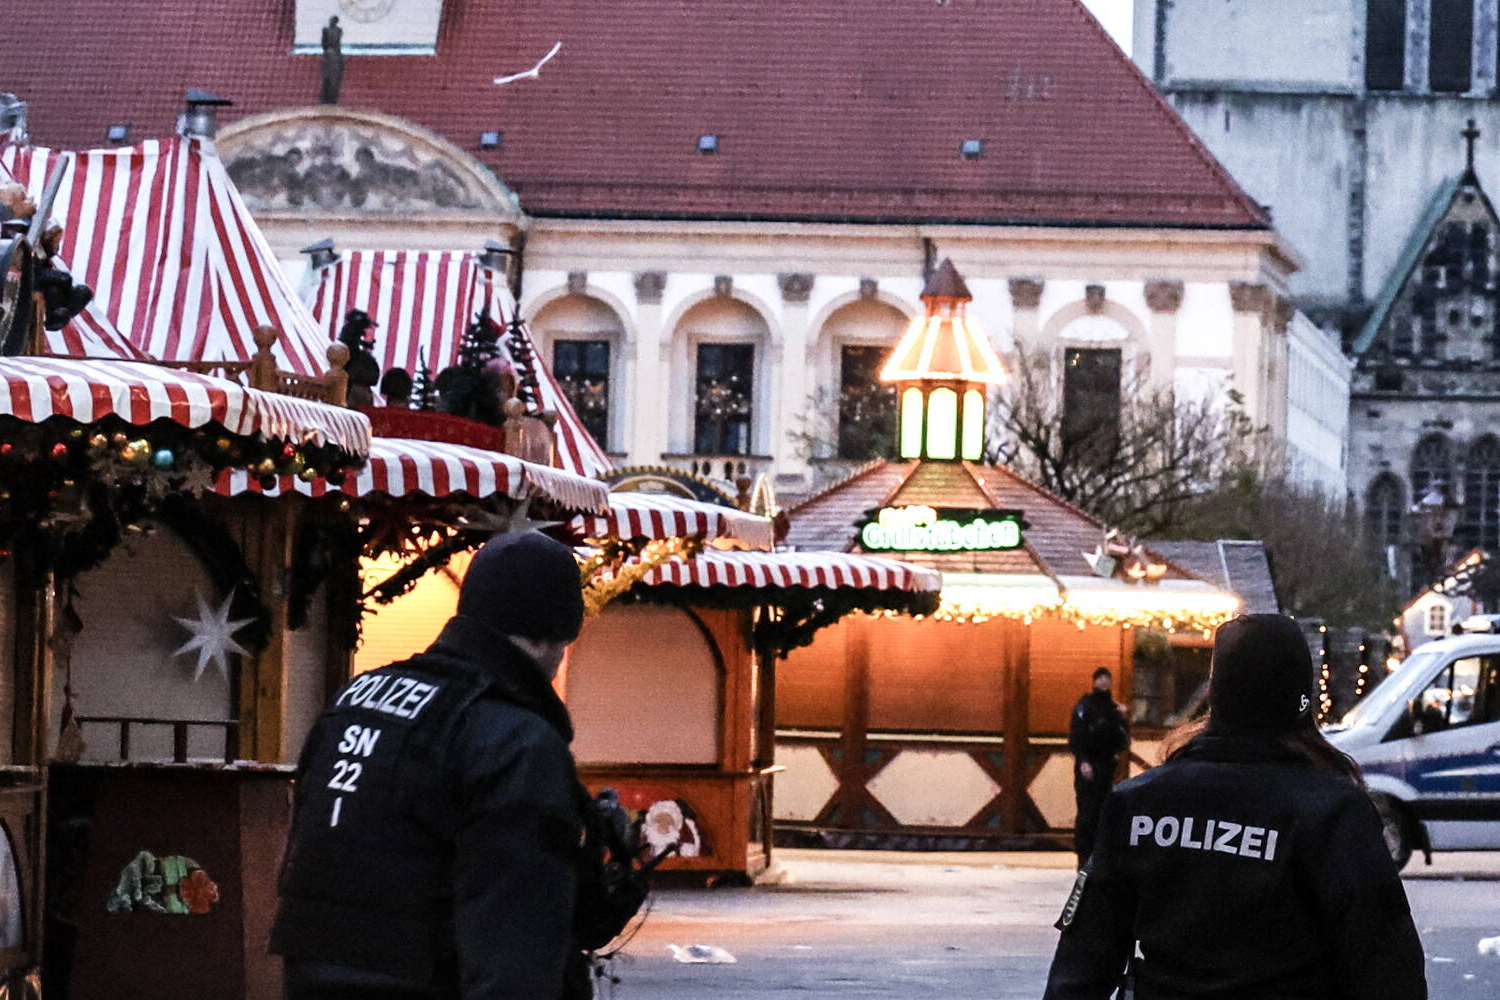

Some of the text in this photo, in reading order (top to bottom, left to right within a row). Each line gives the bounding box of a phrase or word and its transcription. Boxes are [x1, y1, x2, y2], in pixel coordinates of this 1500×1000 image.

[336, 674, 440, 720] POLIZEI
[338, 724, 381, 757] SN
[327, 760, 363, 793] 22
[1129, 815, 1279, 861] POLIZEI
